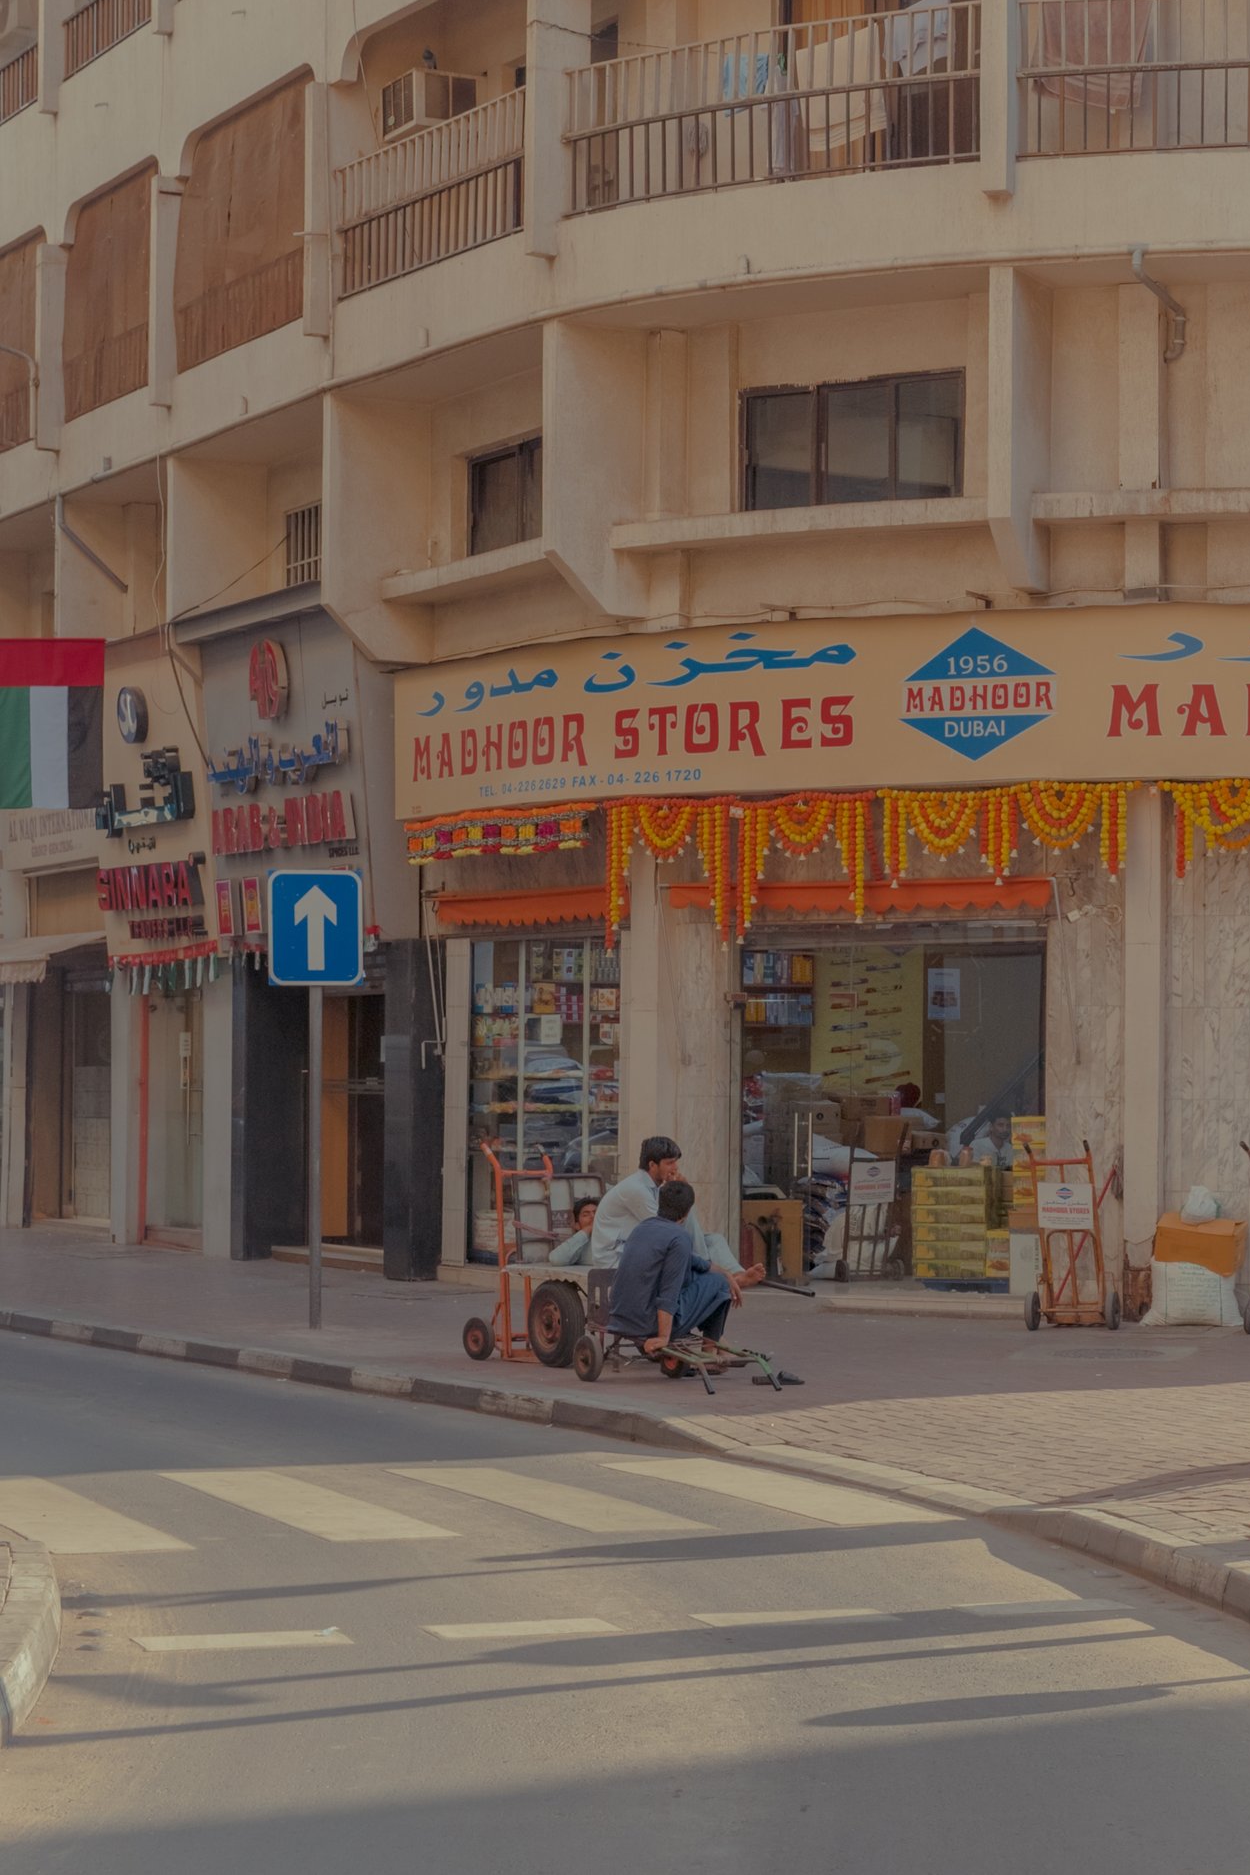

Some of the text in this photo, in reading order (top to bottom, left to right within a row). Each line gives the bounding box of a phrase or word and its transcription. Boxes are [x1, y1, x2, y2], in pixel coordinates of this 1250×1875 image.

[417, 631, 858, 718] مخزن مدور
[946, 654, 1008, 676] 1956
[905, 681, 1054, 713] MADHOOR
[412, 694, 856, 783] MADHOOR STORES
[944, 719, 1006, 738] DUBAI
[479, 785, 498, 798] TEL.
[572, 774, 597, 788] FAX
[665, 768, 702, 782] 1720
[211, 790, 347, 856] ARAB & INDIA
[96, 863, 193, 910] SINNARA
